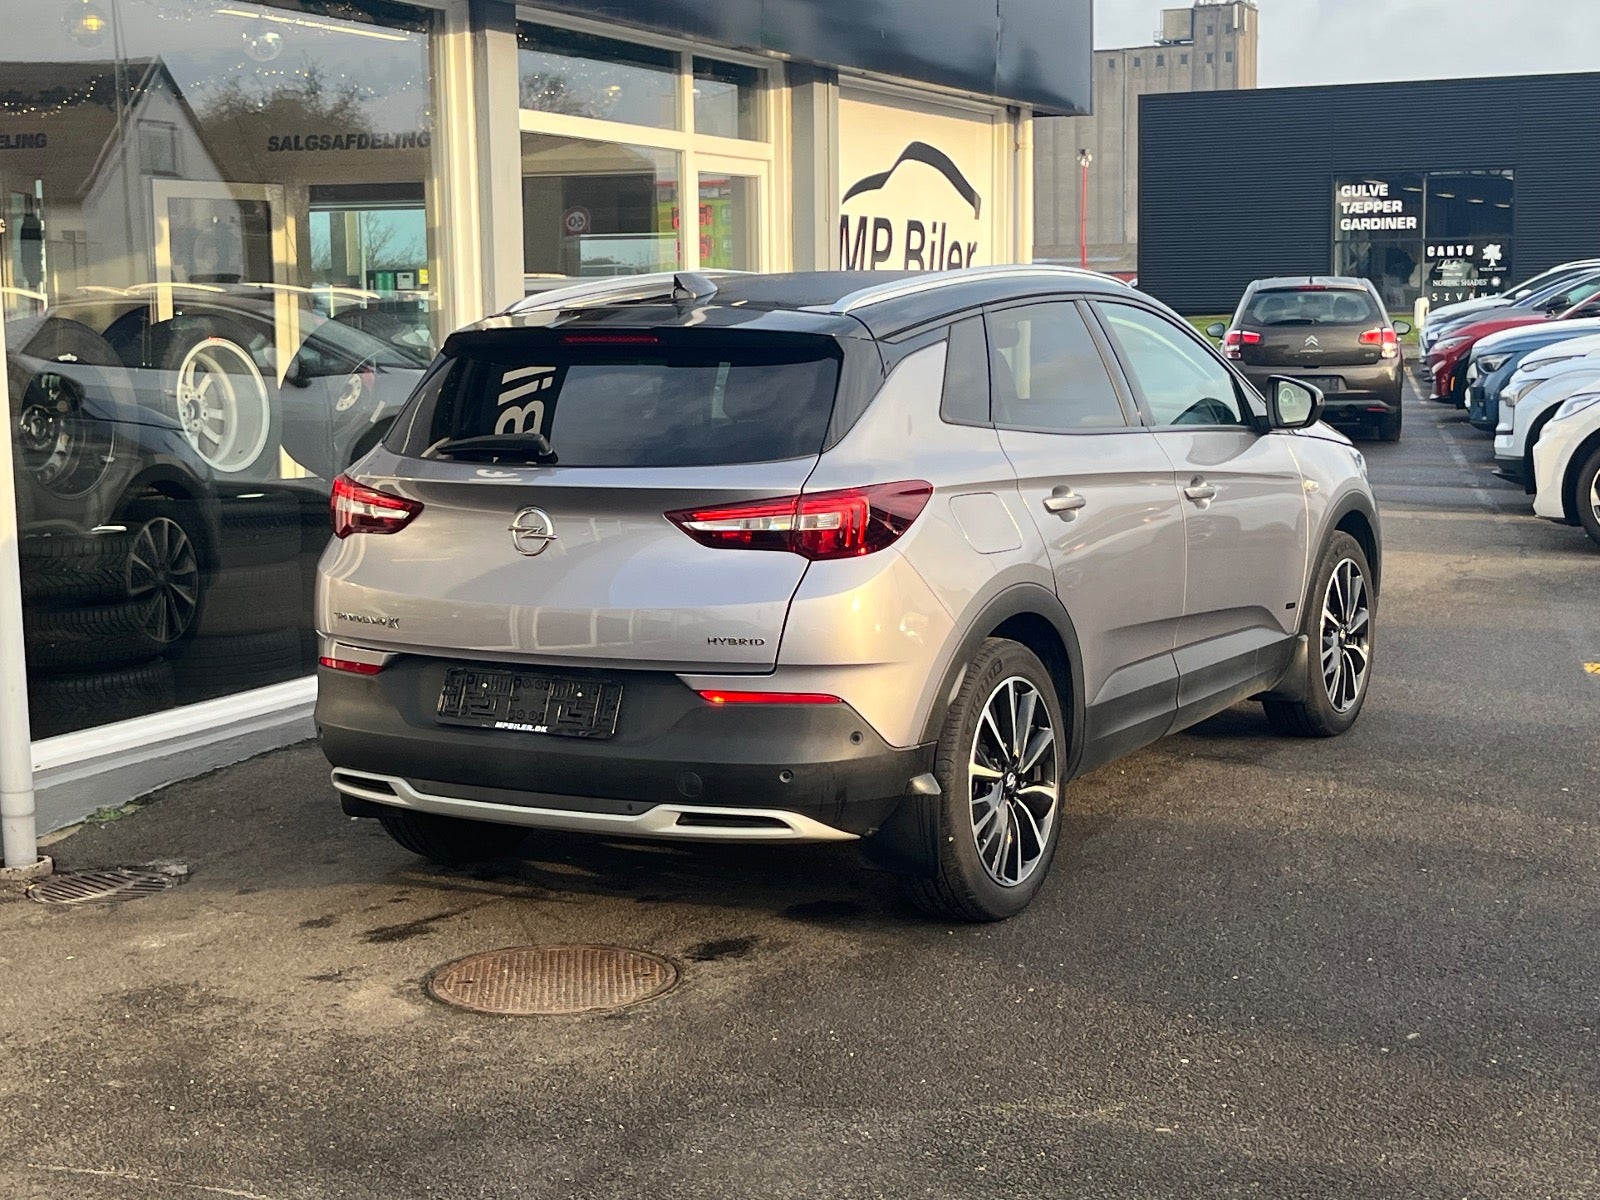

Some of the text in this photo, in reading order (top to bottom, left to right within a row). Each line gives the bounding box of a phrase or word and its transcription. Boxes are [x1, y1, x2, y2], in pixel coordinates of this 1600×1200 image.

[267, 131, 432, 152] SALGSAFDELING
[1341, 184, 1389, 198] GULVE
[1341, 200, 1403, 214] TÆPPER
[1340, 217, 1417, 231] GARDINER
[840, 214, 978, 271] MP Biler
[707, 637, 766, 646] HYBRID
